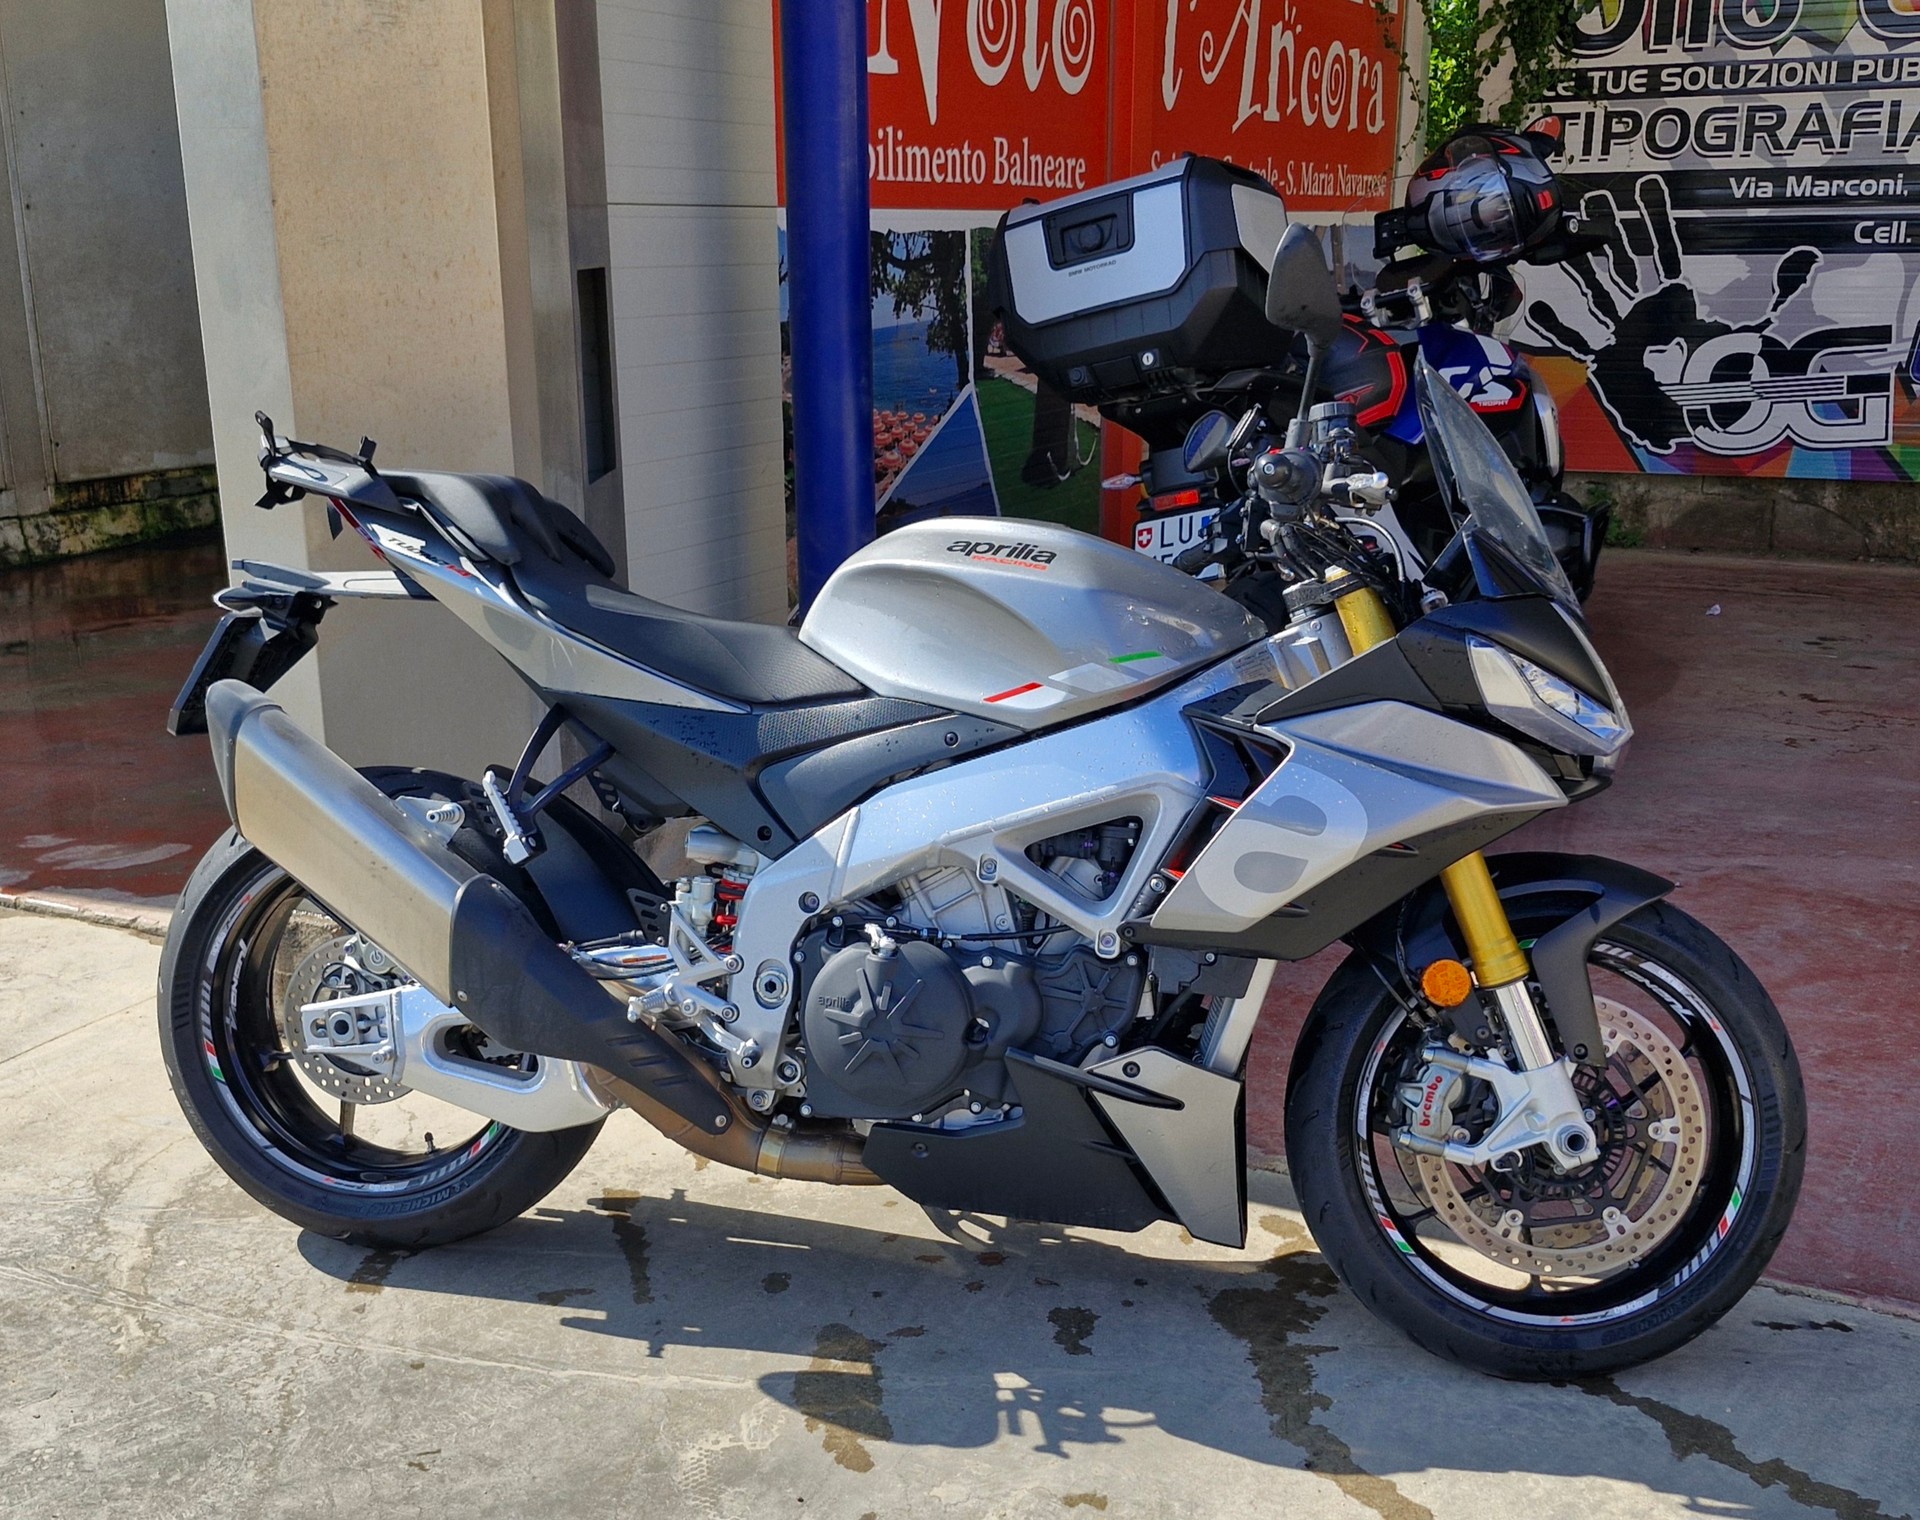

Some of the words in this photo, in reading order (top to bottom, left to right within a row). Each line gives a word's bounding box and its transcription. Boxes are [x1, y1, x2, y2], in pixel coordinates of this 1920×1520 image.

[1587, 69, 1649, 95] TUE
[1660, 60, 1838, 92] SOLUZIONI
[992, 136, 1087, 190] Balneare
[1300, 162, 1335, 196] Maria
[1336, 164, 1387, 198] Navarrese
[1729, 176, 1774, 199] Via
[1785, 173, 1908, 197] Marconi,
[1854, 221, 1911, 244] Cell.
[1160, 515, 1194, 549] LU
[946, 540, 1057, 565] aprilia
[971, 554, 1049, 571] RACING
[1419, 1075, 1443, 1127] brembo
